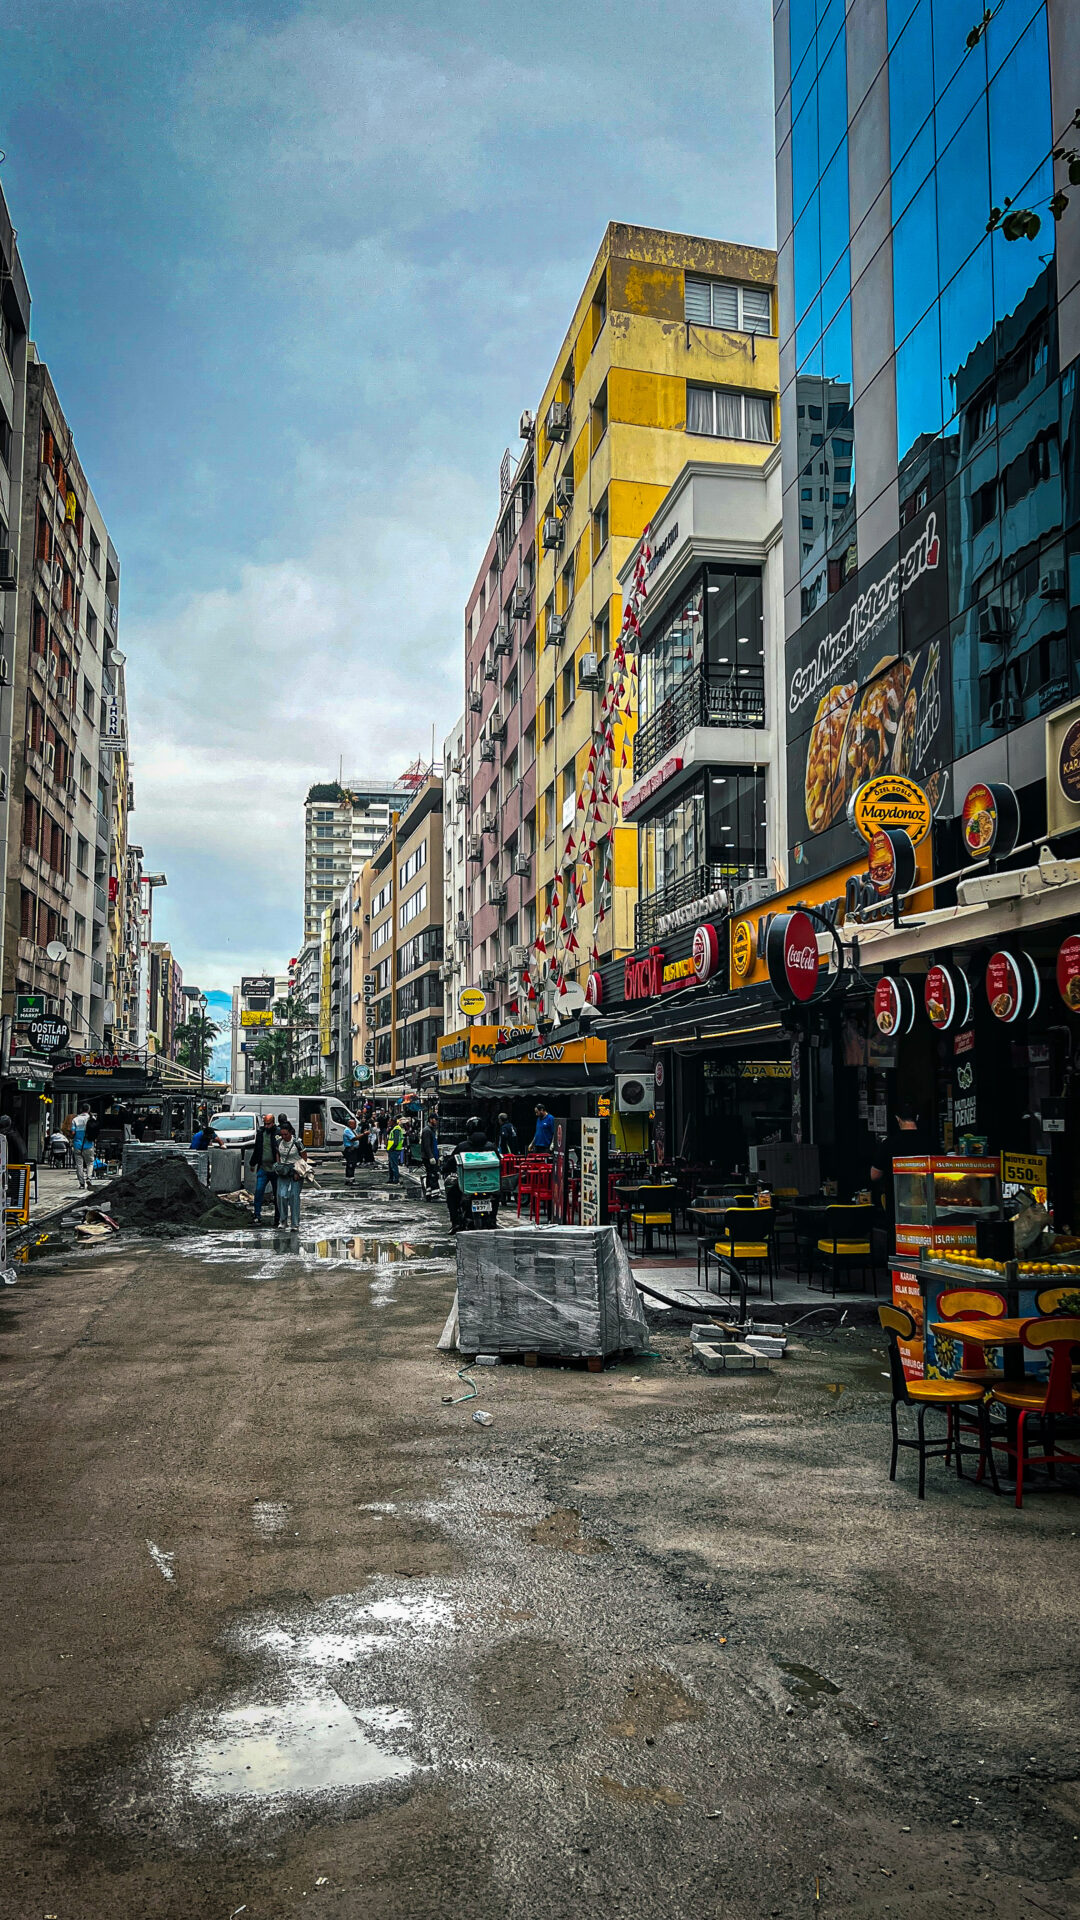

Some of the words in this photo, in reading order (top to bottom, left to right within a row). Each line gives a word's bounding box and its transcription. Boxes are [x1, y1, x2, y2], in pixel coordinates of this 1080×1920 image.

[789, 660, 816, 713] Sen
[874, 786, 890, 796] ÖZEL
[892, 786, 912, 798] SOSLU
[861, 805, 926, 822] Maydonoz
[31, 1023, 67, 1035] DOSTLAR
[36, 1034, 60, 1045] FIRINI
[935, 1235, 955, 1244] ISLAK
